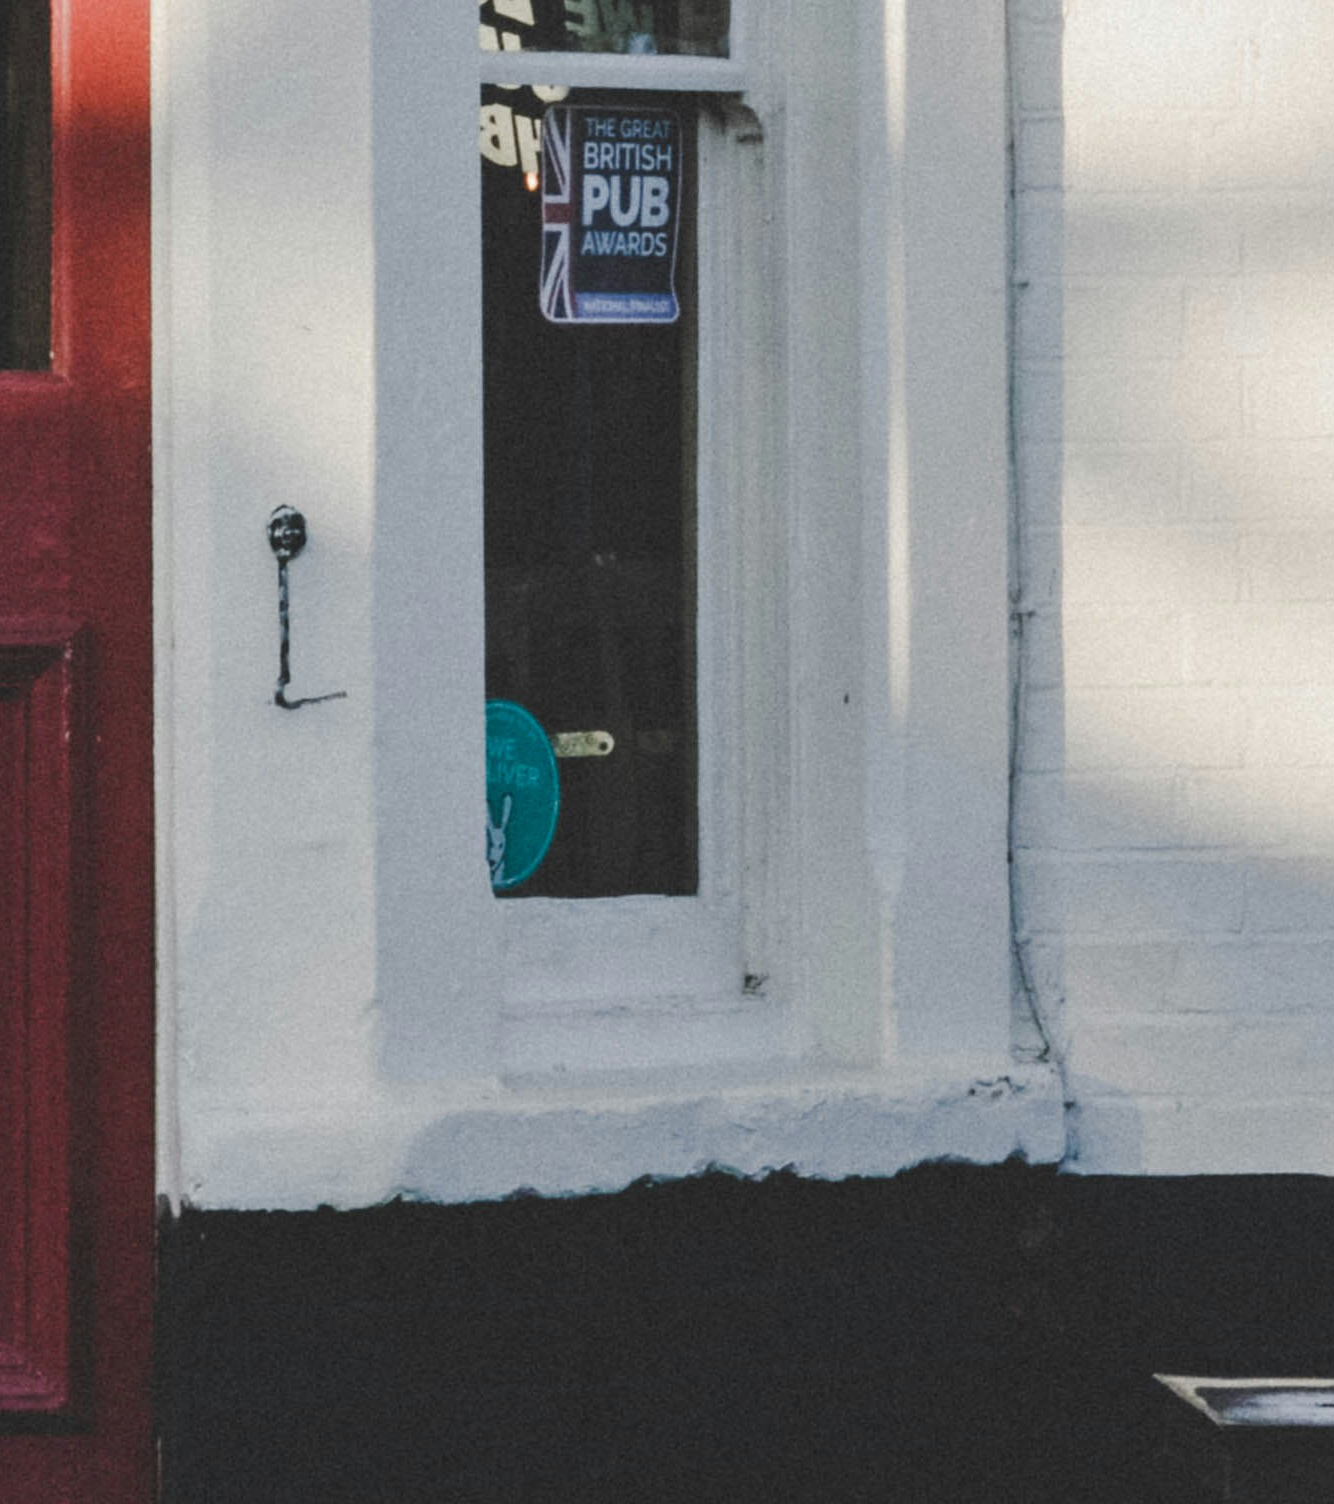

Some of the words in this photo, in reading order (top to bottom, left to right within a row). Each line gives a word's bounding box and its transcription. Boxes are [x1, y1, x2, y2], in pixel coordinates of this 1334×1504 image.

[585, 117, 615, 137] THE
[619, 118, 671, 139] GREAT
[582, 141, 672, 171] BRITISH
[582, 174, 670, 227] PUB
[581, 231, 668, 257] AWARDS
[486, 763, 541, 787] LIVER
